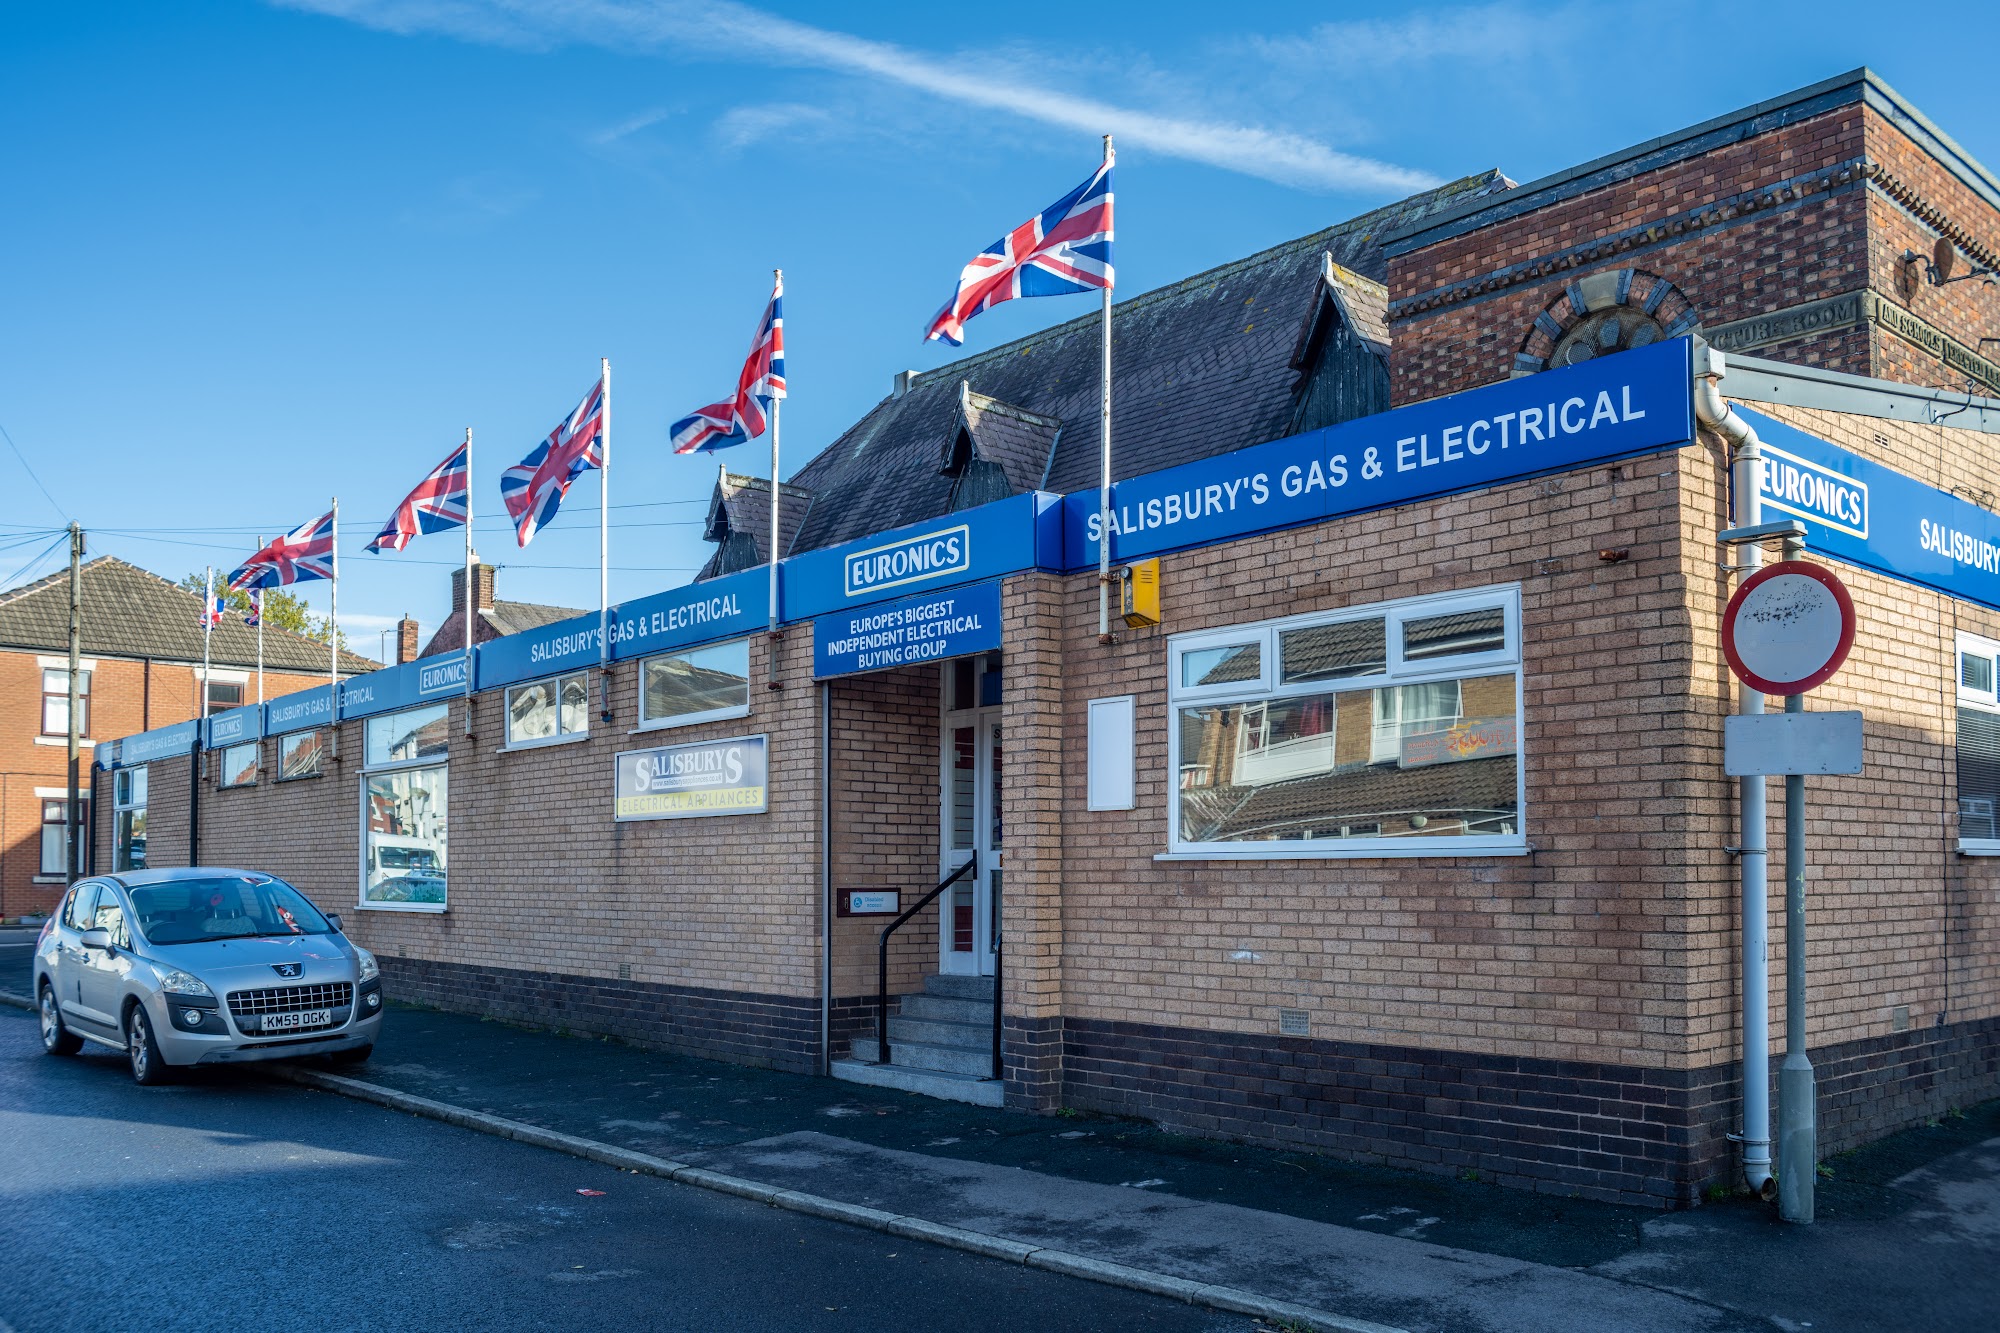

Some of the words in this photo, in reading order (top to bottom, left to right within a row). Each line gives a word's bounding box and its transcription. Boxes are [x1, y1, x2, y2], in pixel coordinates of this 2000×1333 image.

[1789, 301, 1854, 332] ROOM
[1899, 314, 1941, 352] SCHOOLS
[1087, 472, 1270, 542] SALISBURY'S
[1281, 453, 1349, 497] GAS
[1361, 445, 1384, 480] &
[1396, 384, 1646, 473] ELECTRICAL
[1760, 455, 1861, 526] EURONICS
[852, 536, 960, 587] EURONICS
[1920, 518, 2000, 575] SALISBURY
[531, 627, 603, 663] SALISBURY'S
[608, 619, 635, 644] GAS
[638, 616, 648, 637] &
[651, 593, 742, 635] ELECTRICAL
[827, 628, 905, 656] INDEPENDENT
[906, 614, 982, 642] ELECTRICAL
[850, 610, 903, 635] EUROPE'S
[905, 599, 955, 624] BIGGEST
[858, 647, 902, 668] BUYING
[904, 639, 947, 661] GROUP
[271, 701, 311, 724] SALISBURY'S
[311, 698, 325, 714] GAS
[325, 697, 331, 713] &
[335, 686, 375, 709] LECTRICAL
[214, 719, 242, 738] EURONICS
[634, 747, 743, 792] SALISBURYS
[622, 794, 683, 813] ELECTRICAL
[687, 789, 758, 809] APPLIANCES
[267, 1014, 299, 1028] KM59
[303, 1011, 326, 1024] OGK
